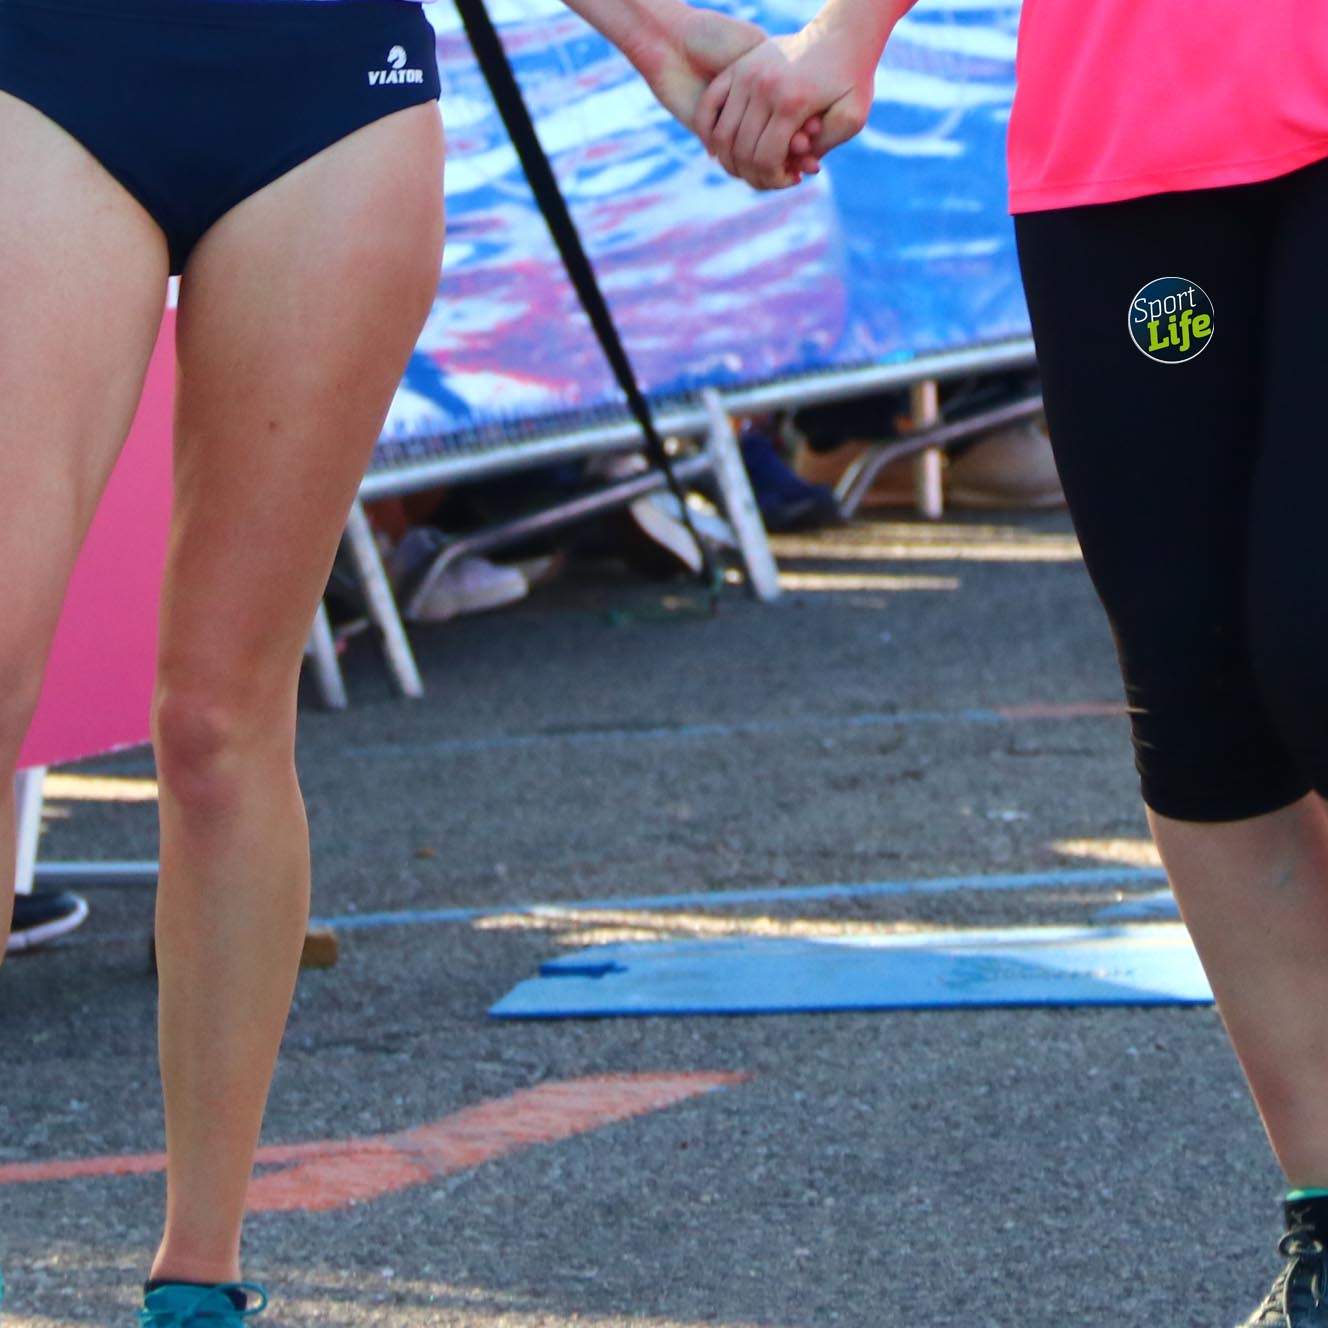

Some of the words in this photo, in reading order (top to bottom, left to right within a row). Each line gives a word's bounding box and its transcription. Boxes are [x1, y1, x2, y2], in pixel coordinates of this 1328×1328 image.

[367, 68, 424, 86] VIATOR
[1133, 285, 1197, 324] Sport
[1147, 309, 1212, 353] Life
